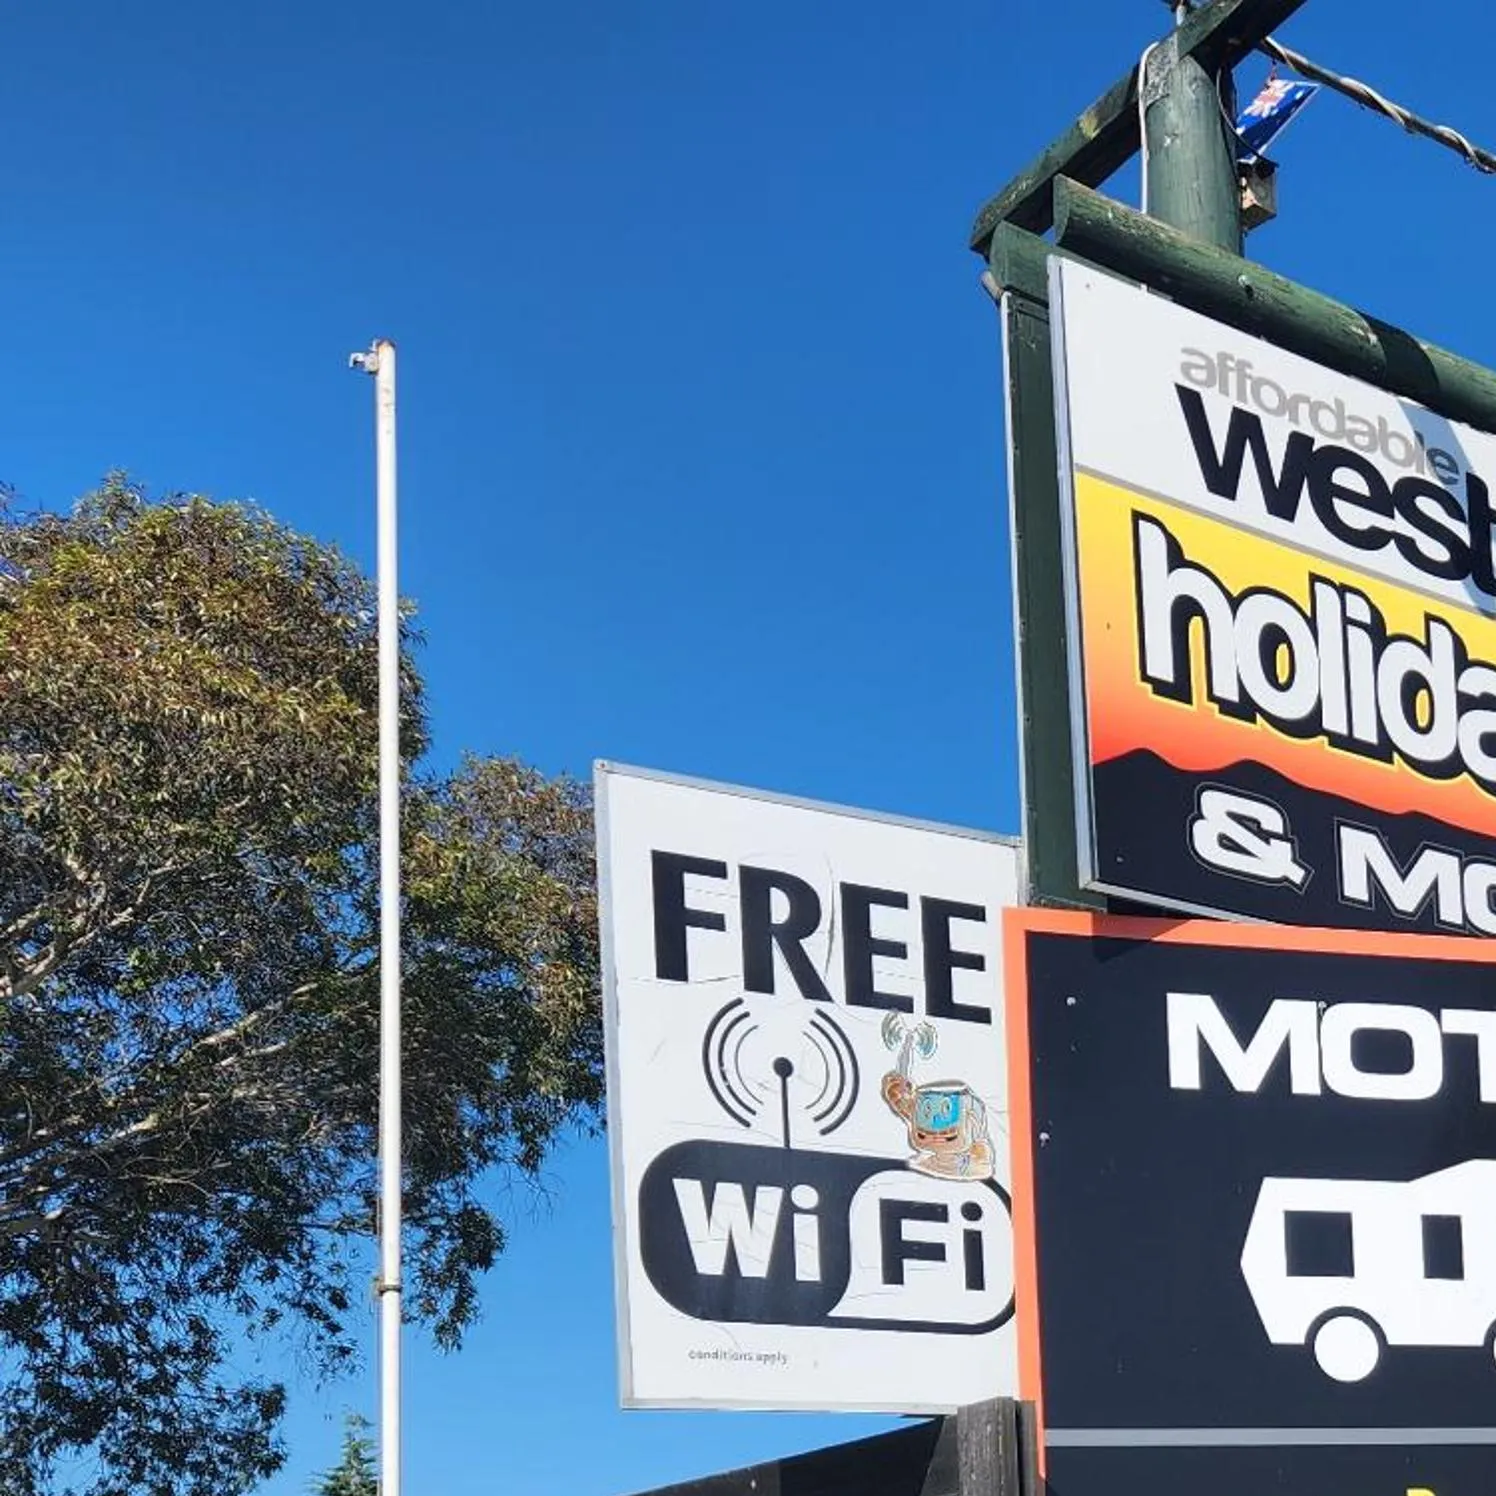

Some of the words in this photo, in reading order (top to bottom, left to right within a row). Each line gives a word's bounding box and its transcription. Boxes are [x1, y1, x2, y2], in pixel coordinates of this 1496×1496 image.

[1179, 346, 1460, 486] affordable
[1193, 789, 1306, 886] &
[651, 849, 992, 1025] FREE
